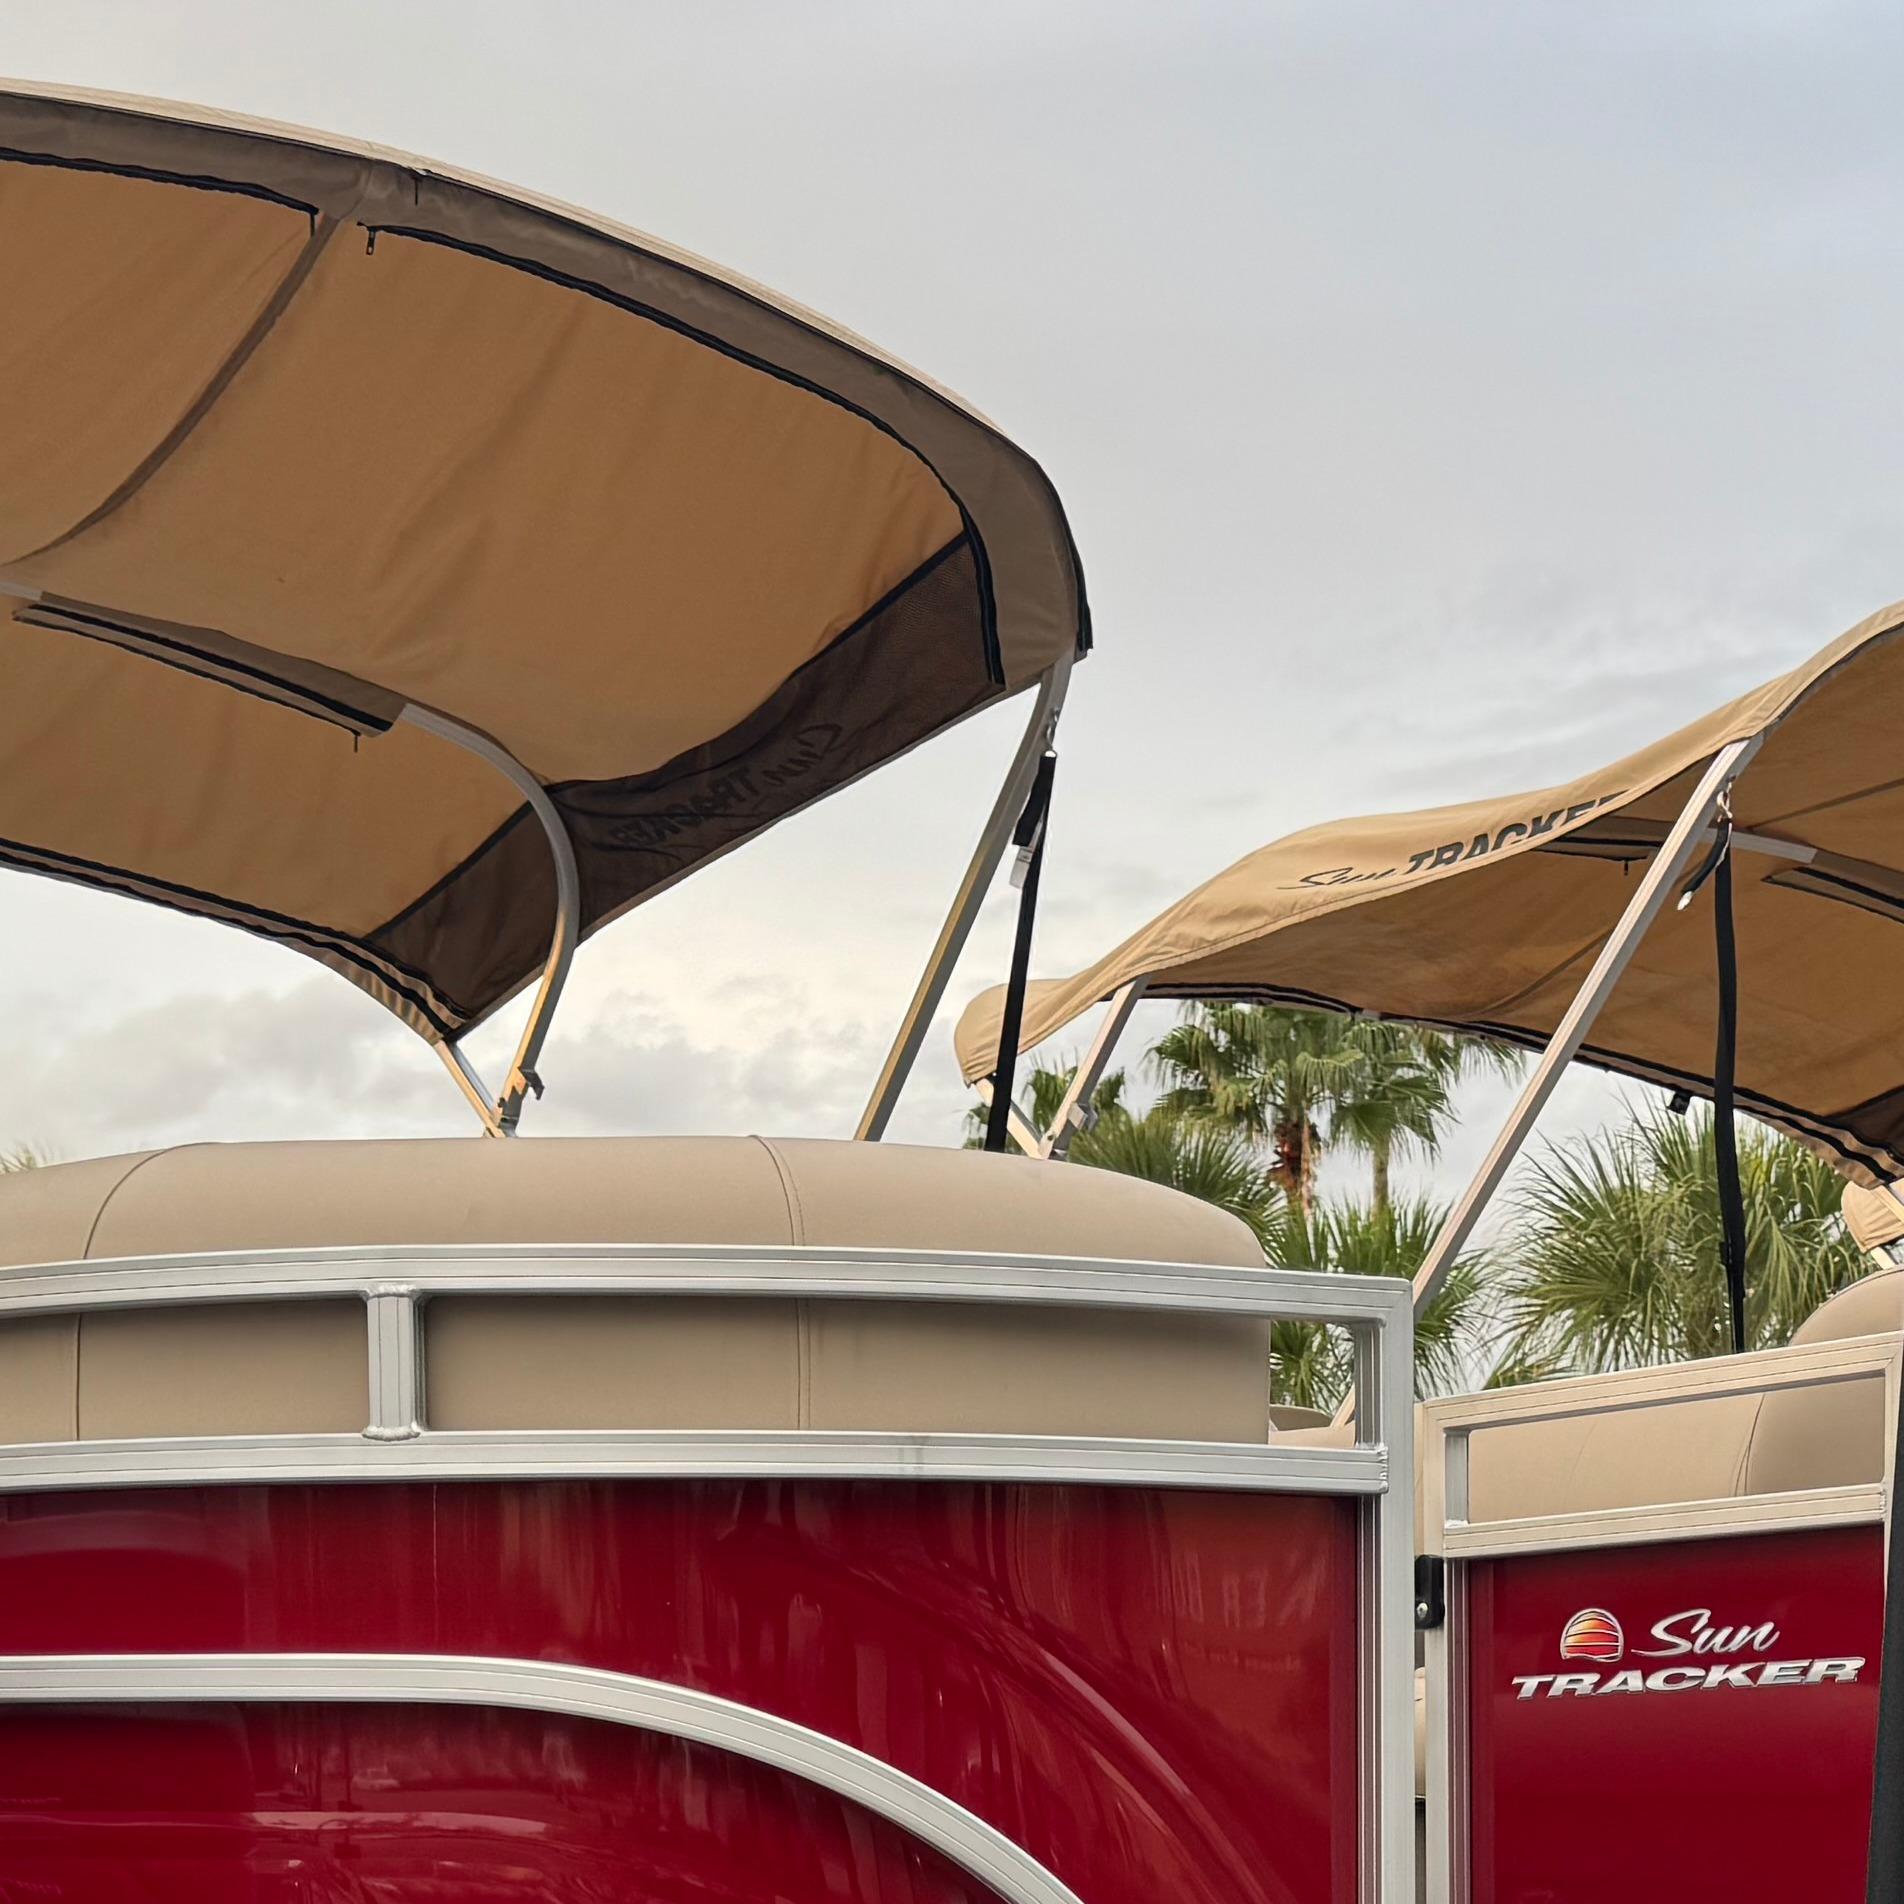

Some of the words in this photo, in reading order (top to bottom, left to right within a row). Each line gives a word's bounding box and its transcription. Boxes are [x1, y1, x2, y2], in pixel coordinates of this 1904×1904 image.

[1403, 789, 1630, 875] TRACKE
[1631, 1608, 1781, 1657] Sun
[1511, 1656, 1866, 1700] TRACKER
